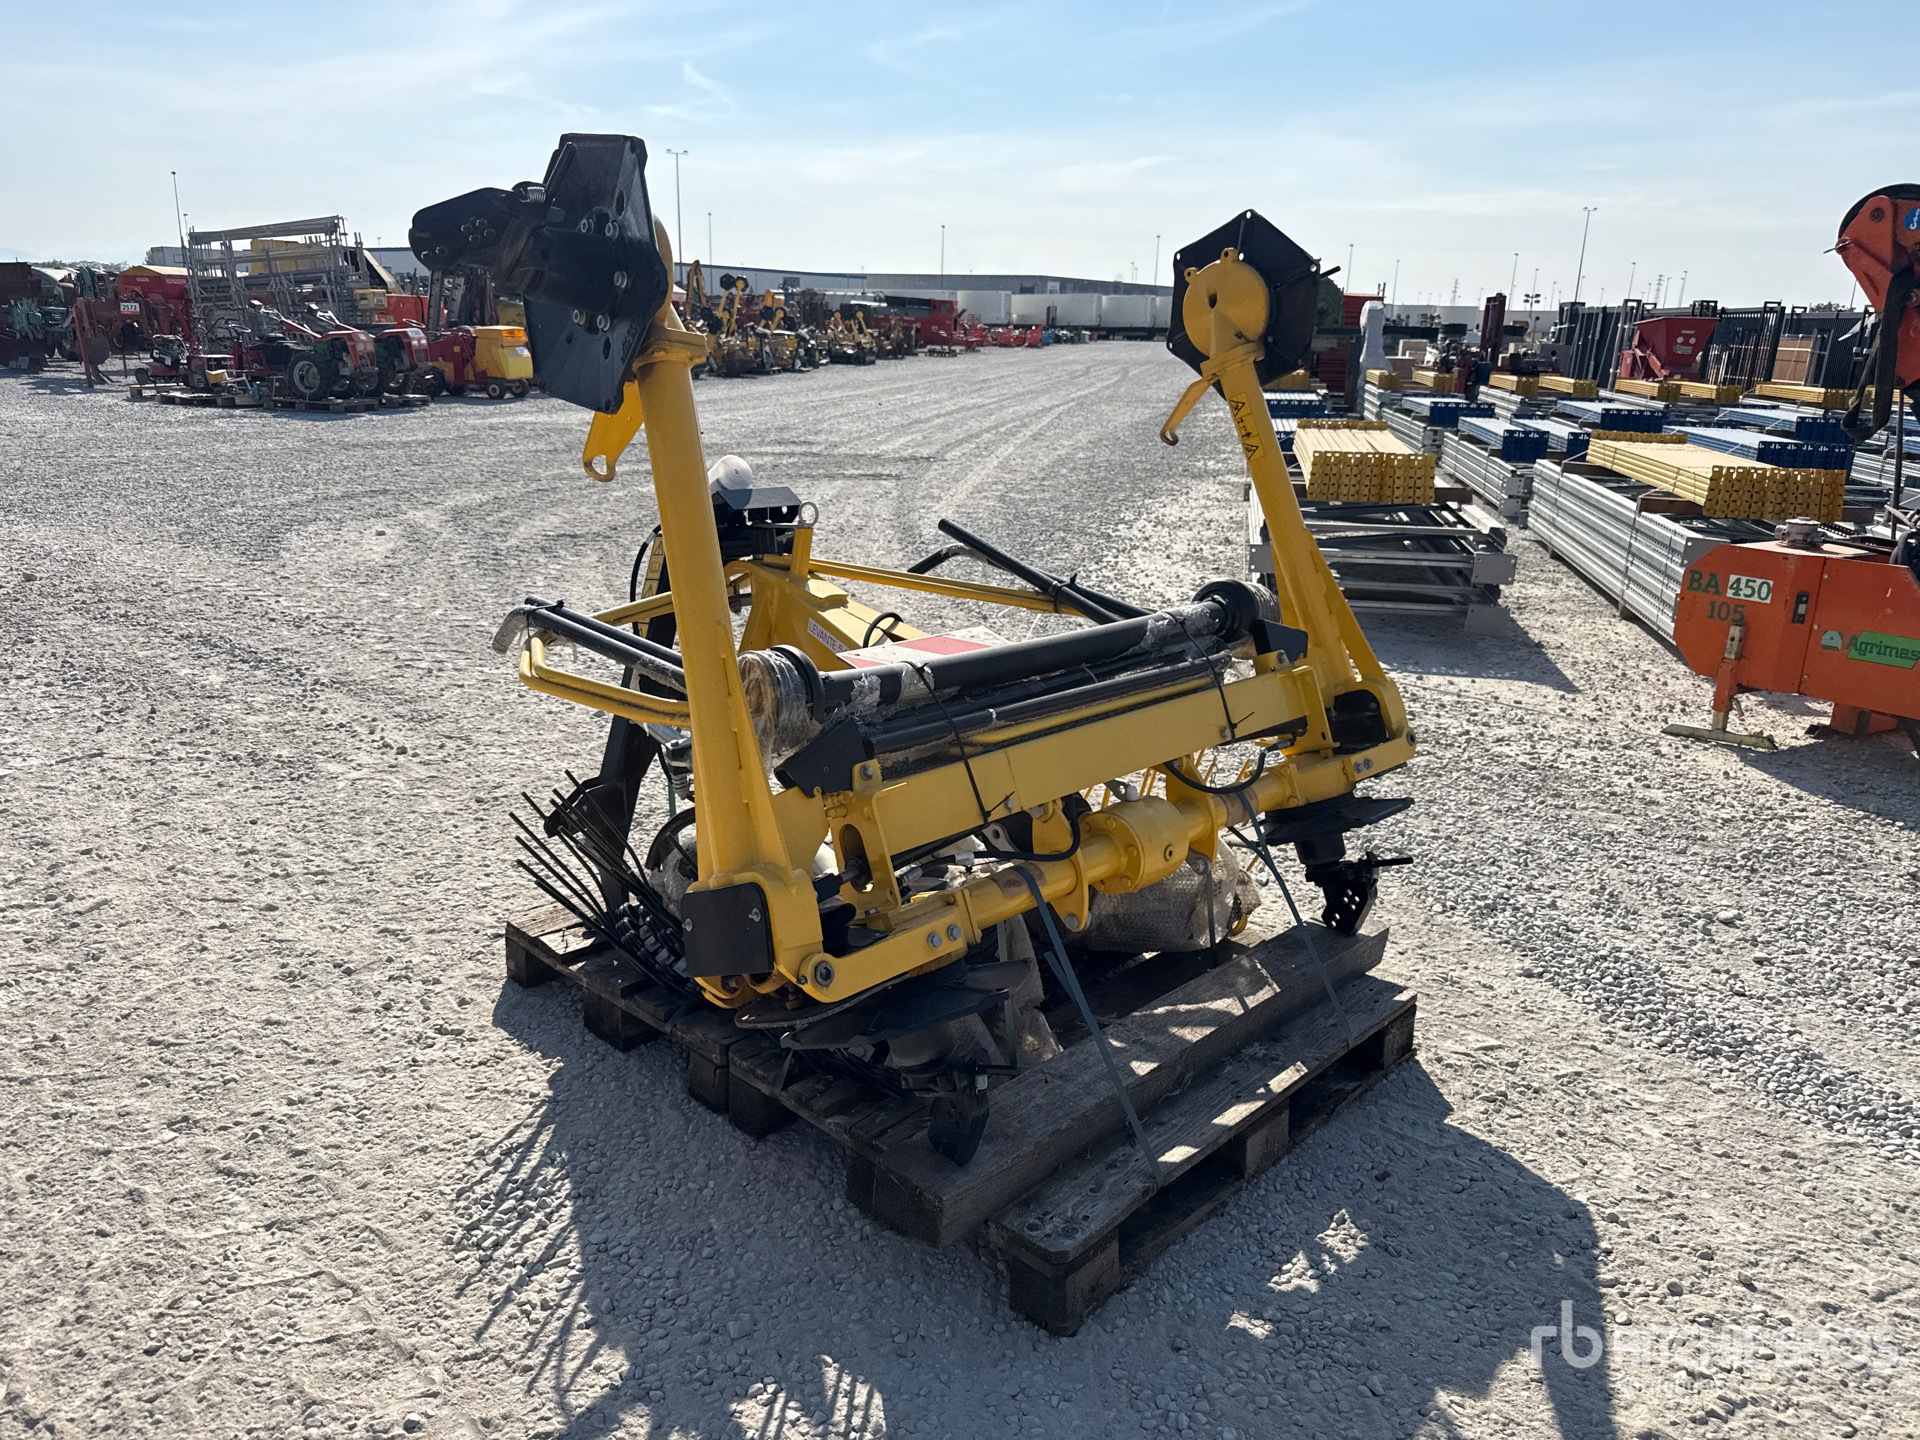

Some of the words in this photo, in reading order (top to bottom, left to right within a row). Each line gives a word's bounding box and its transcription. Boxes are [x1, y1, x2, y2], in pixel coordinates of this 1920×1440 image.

[1687, 570, 1722, 596] BA
[1729, 577, 1771, 601] 450
[1708, 601, 1745, 623] 105
[809, 620, 838, 651] LEVANTE
